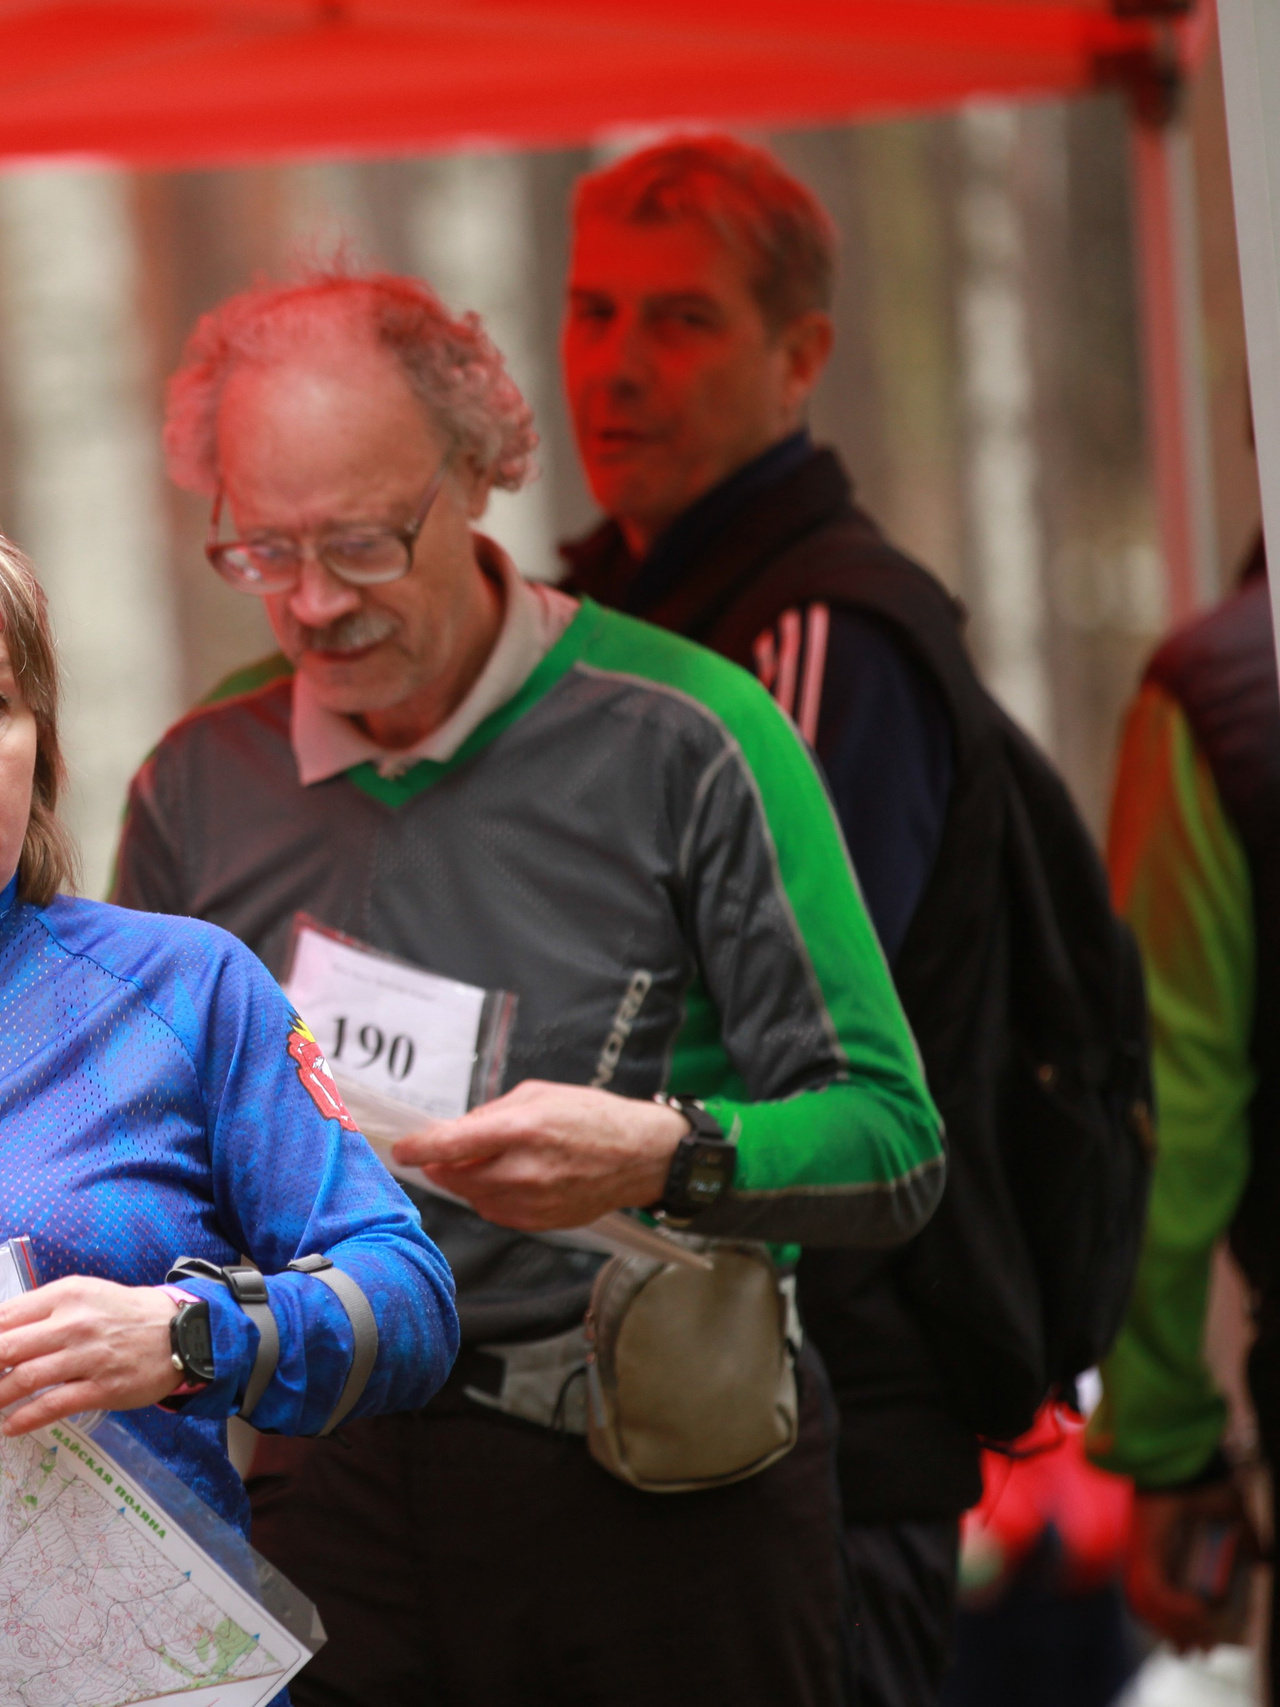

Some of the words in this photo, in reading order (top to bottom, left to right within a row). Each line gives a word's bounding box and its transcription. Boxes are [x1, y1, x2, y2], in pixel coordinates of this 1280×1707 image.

[331, 1016, 415, 1081] 190
[50, 1427, 114, 1486] МАЙСКАЯ
[114, 1485, 167, 1540] ПОЛЯНА
